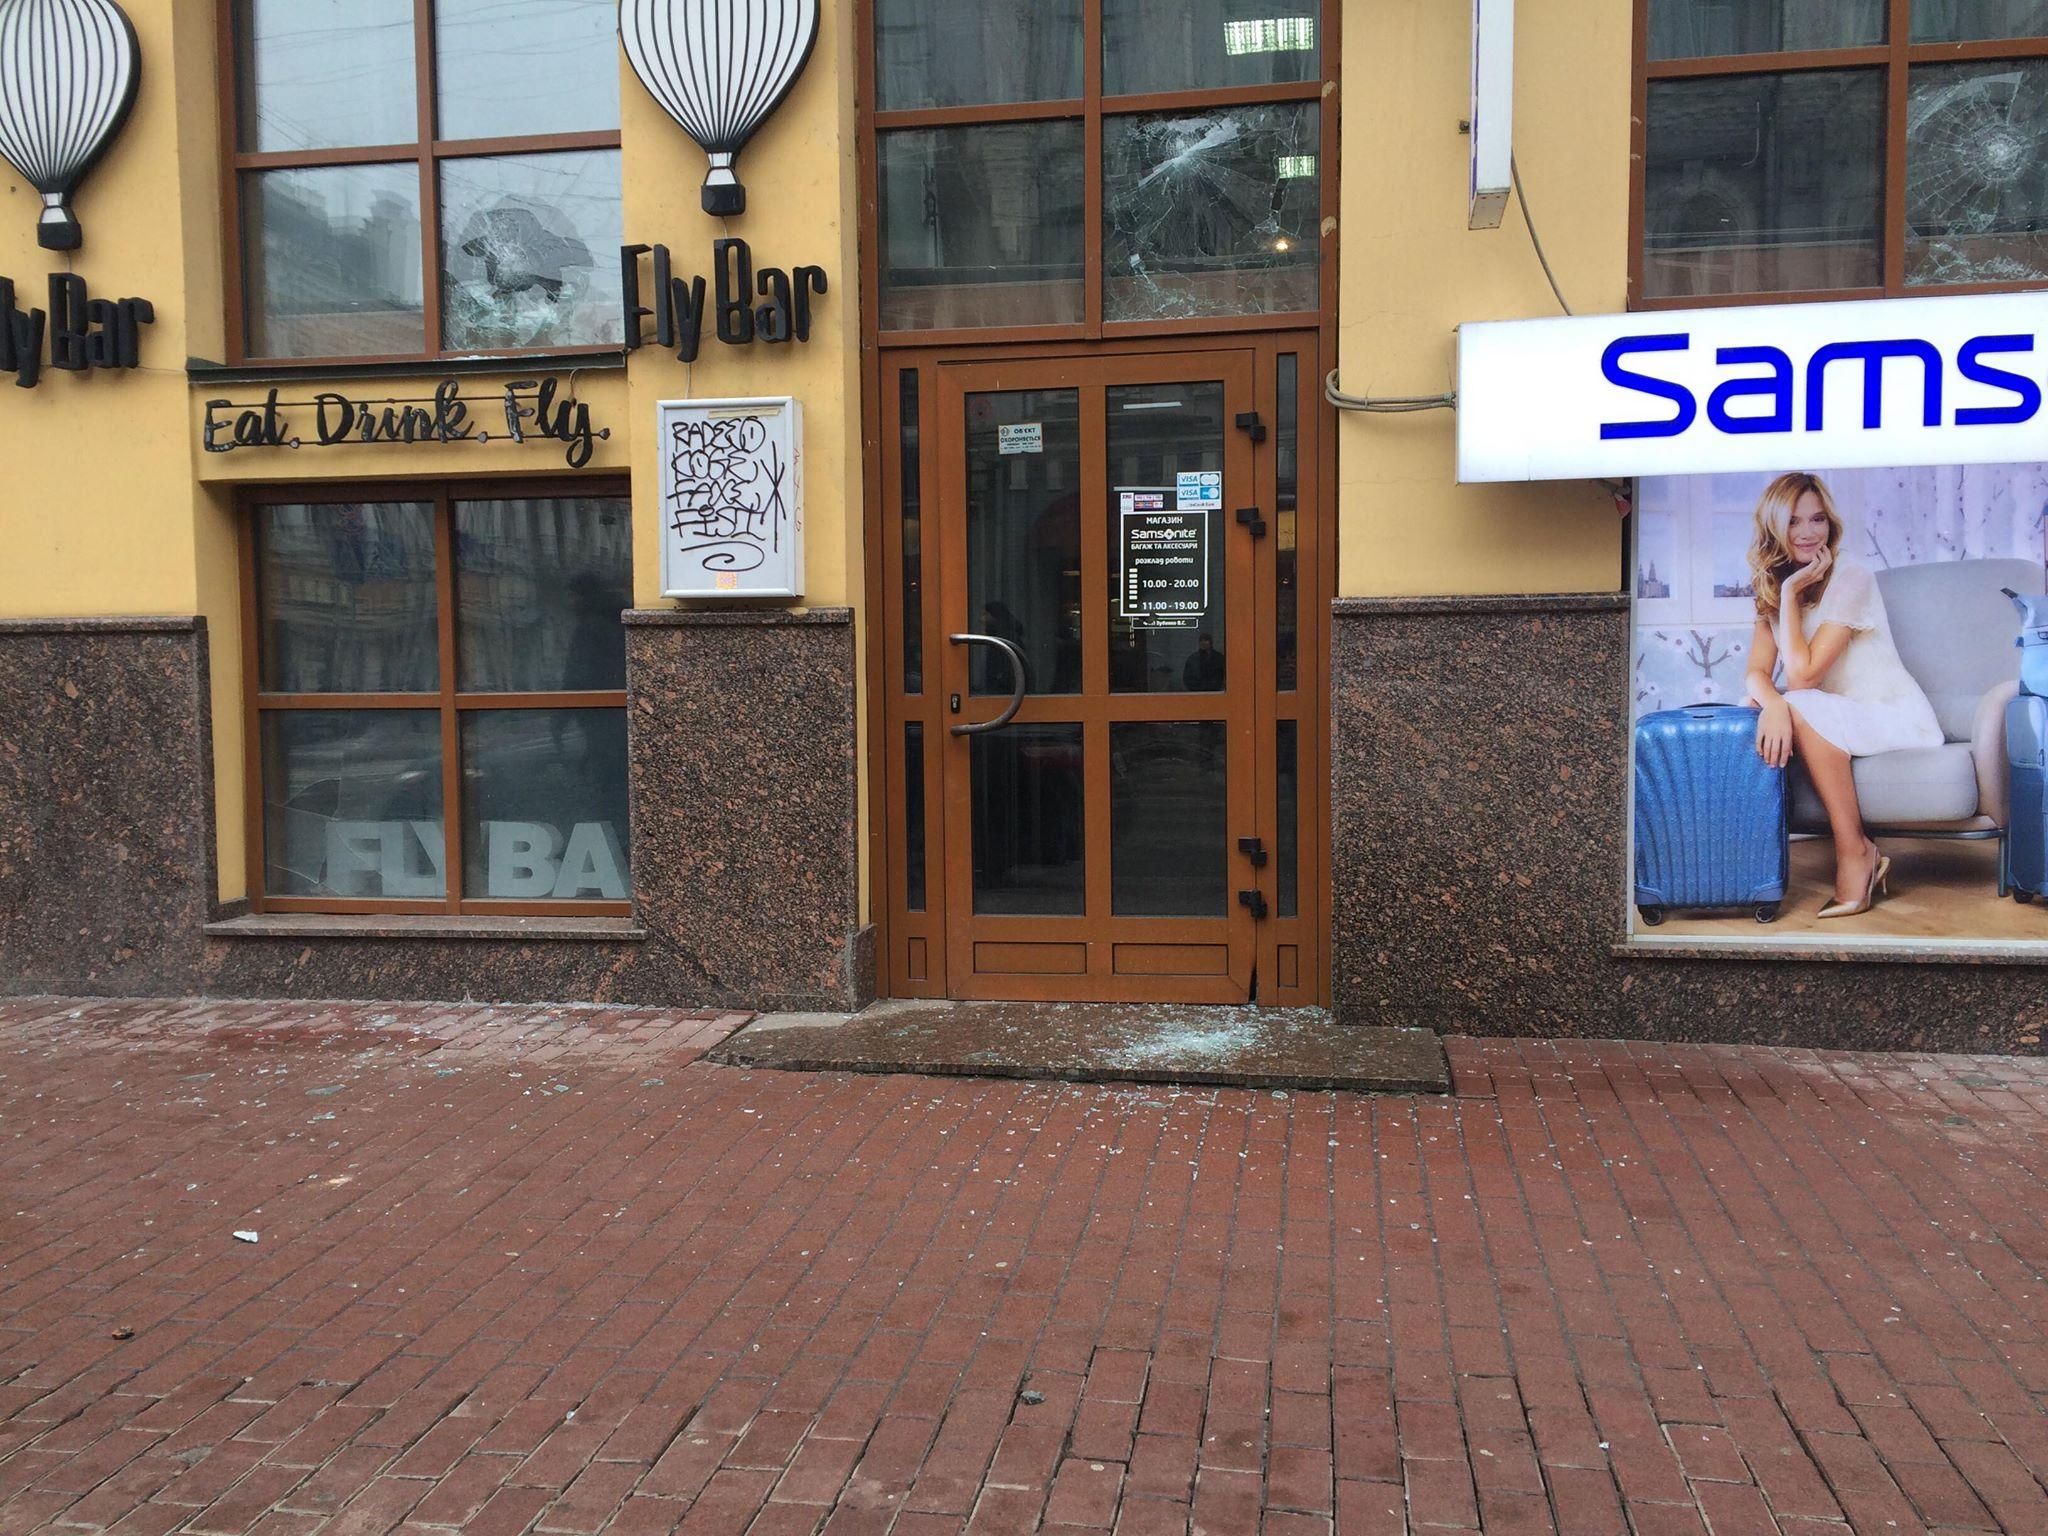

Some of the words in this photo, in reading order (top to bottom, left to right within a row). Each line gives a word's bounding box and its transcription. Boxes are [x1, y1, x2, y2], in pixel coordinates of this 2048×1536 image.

[621, 243, 706, 362] Fly
[714, 238, 828, 344] Bar
[48, 273, 154, 370] Bar
[1601, 333, 2042, 440] Sams
[204, 389, 300, 453] Eat.
[313, 379, 488, 446] Drink.
[503, 376, 610, 469] Fly.
[1181, 475, 1198, 483] VISA
[1146, 516, 1183, 525] МАГАЗИН
[1135, 557, 1163, 566] розклад
[1165, 556, 1194, 565] роботи
[1142, 579, 1167, 588] 10.00
[1174, 579, 1199, 588] 20.00
[1142, 601, 1167, 610] 11.00
[1174, 601, 1199, 610] 19.00
